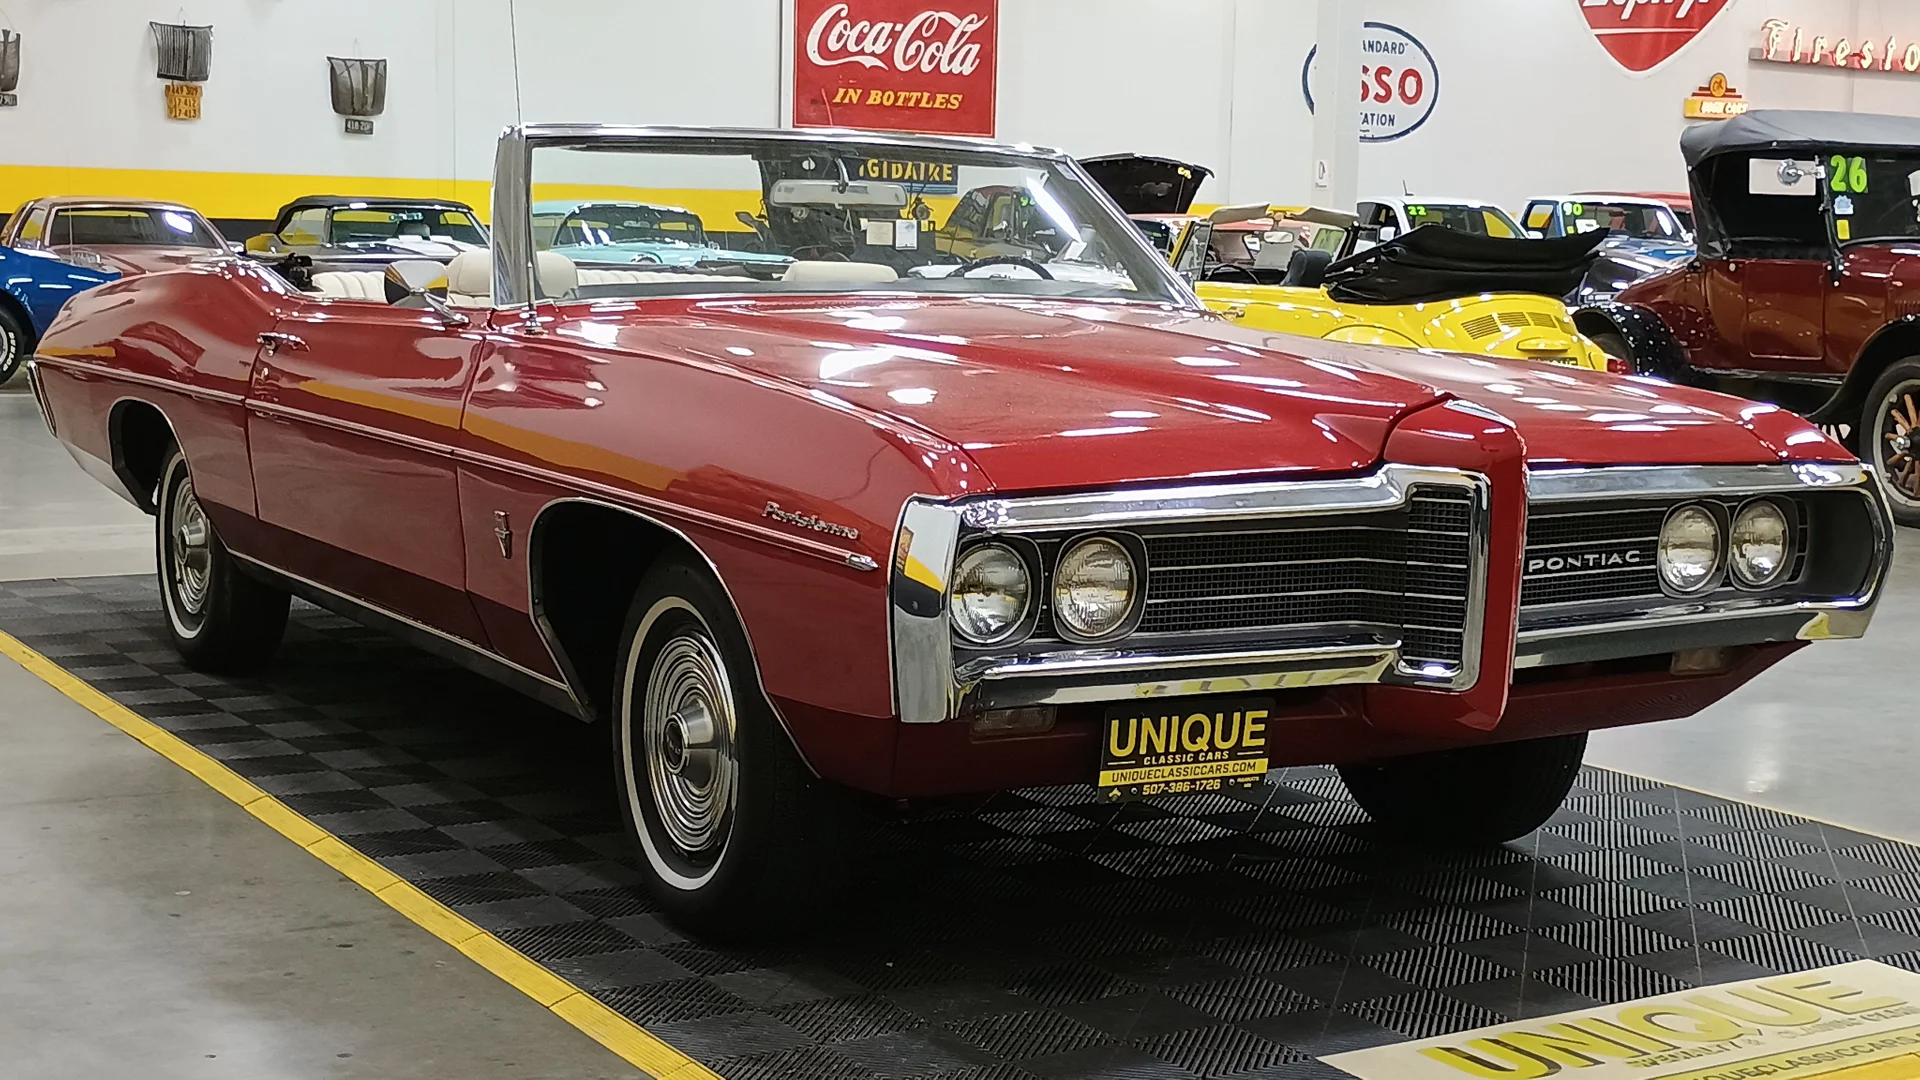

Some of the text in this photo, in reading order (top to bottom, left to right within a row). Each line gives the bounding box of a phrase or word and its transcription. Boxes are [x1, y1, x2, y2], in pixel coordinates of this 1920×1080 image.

[807, 3, 988, 76] Coca-Cola
[832, 88, 963, 110] IN BOTTLES
[1360, 113, 1396, 127] ATION
[1830, 155, 1868, 193] 26
[1407, 205, 1428, 216] 22
[1562, 202, 1583, 217] 90
[1528, 550, 1641, 573] PONTIAC
[1110, 710, 1268, 757] UNIQUE
[1143, 751, 1230, 766] CLASSIC CARS
[1111, 761, 1257, 783] UNIQUECLASSICCARS.COM
[1142, 778, 1222, 796] 507-386-1726
[1418, 973, 1909, 1080] UNIQUE
